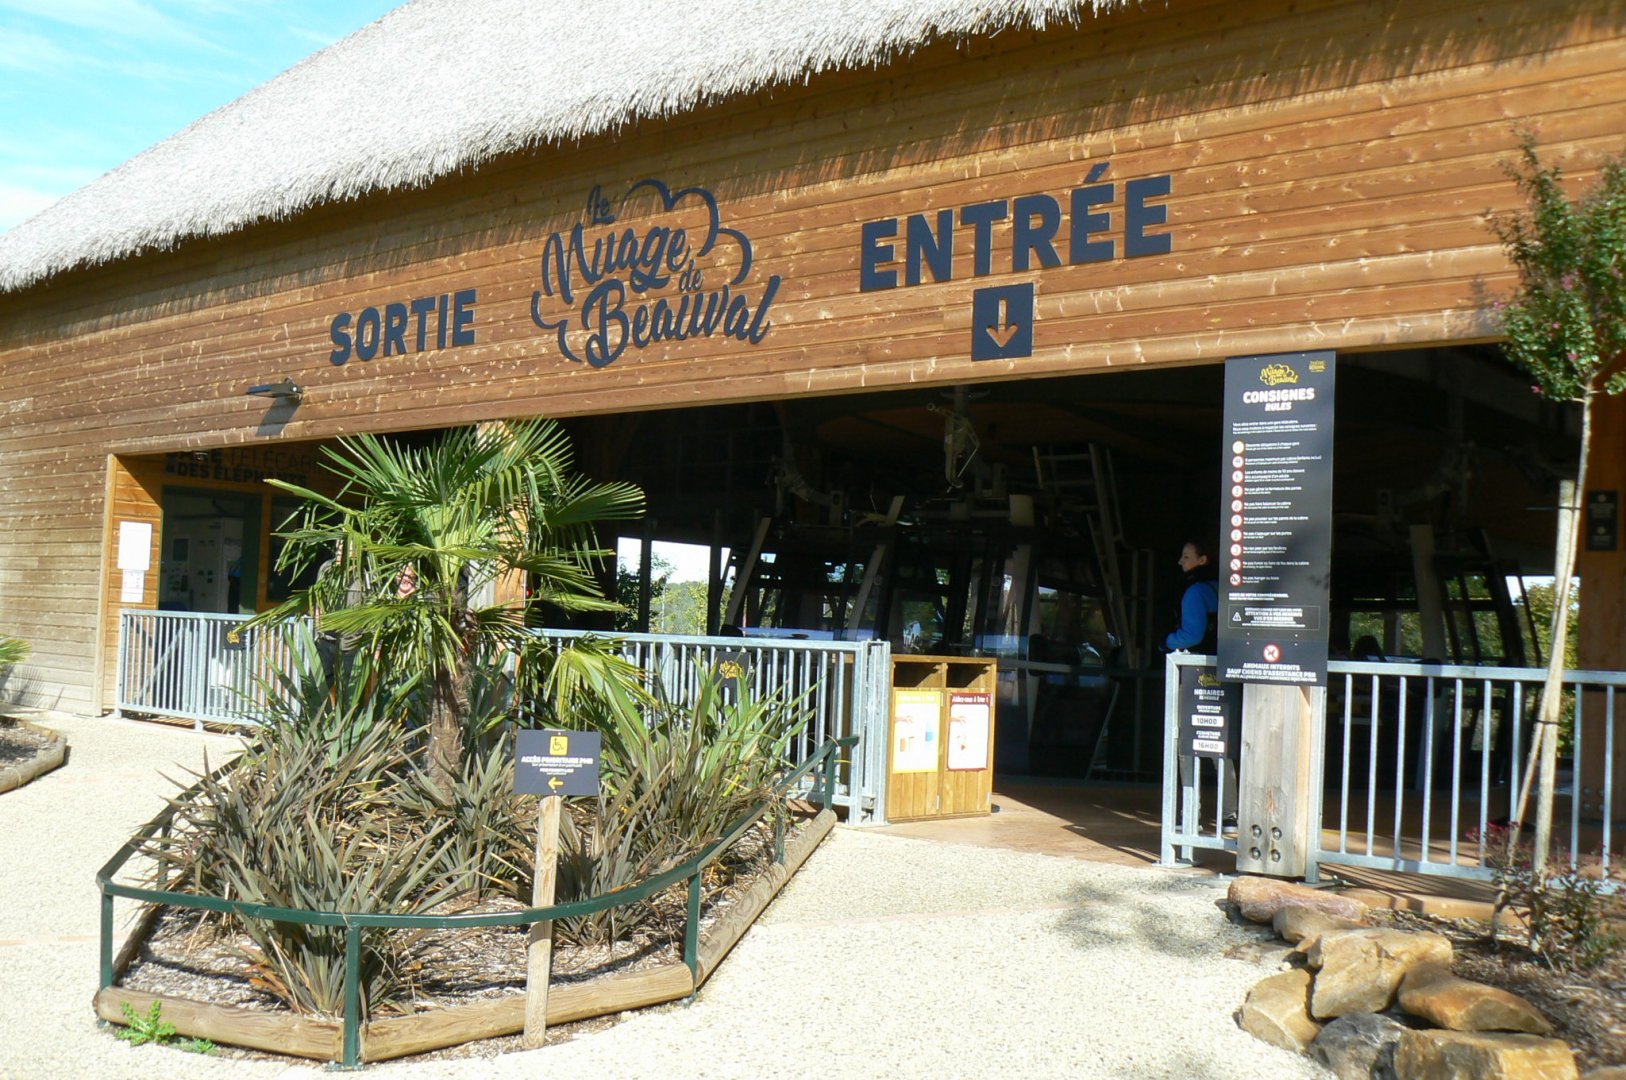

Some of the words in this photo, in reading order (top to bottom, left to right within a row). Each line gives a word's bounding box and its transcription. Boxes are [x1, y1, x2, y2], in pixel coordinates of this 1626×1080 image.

[542, 222, 692, 305] Nuage
[860, 162, 1173, 293] ENTRÉE
[679, 259, 703, 293] de
[329, 288, 477, 366] SORTIE
[581, 275, 782, 368] Beauval
[1243, 388, 1315, 404] CONSIGNES
[1264, 402, 1292, 411] RULES
